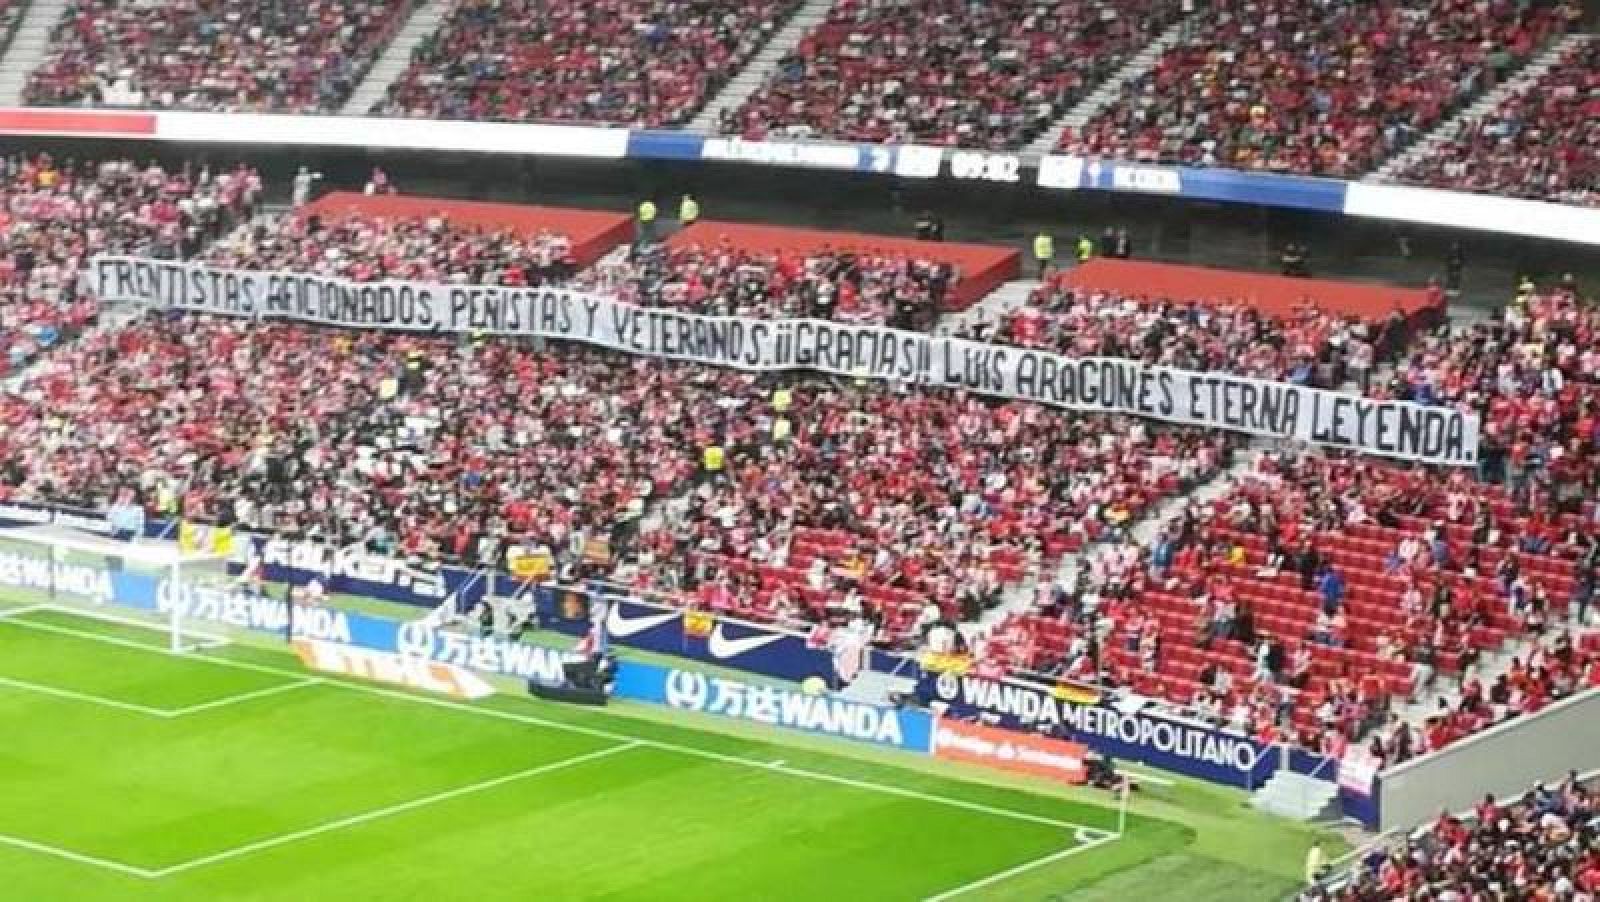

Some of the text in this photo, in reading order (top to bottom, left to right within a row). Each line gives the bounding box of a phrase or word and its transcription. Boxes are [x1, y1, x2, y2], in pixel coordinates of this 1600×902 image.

[450, 288, 571, 333] PEÑISTAS
[582, 298, 601, 338] Y
[1189, 376, 1299, 437] ETERNA
[1311, 391, 1474, 462] LEYENDA.
[962, 678, 1062, 726] WANDA
[1062, 704, 1257, 771] METROPOLITANO
